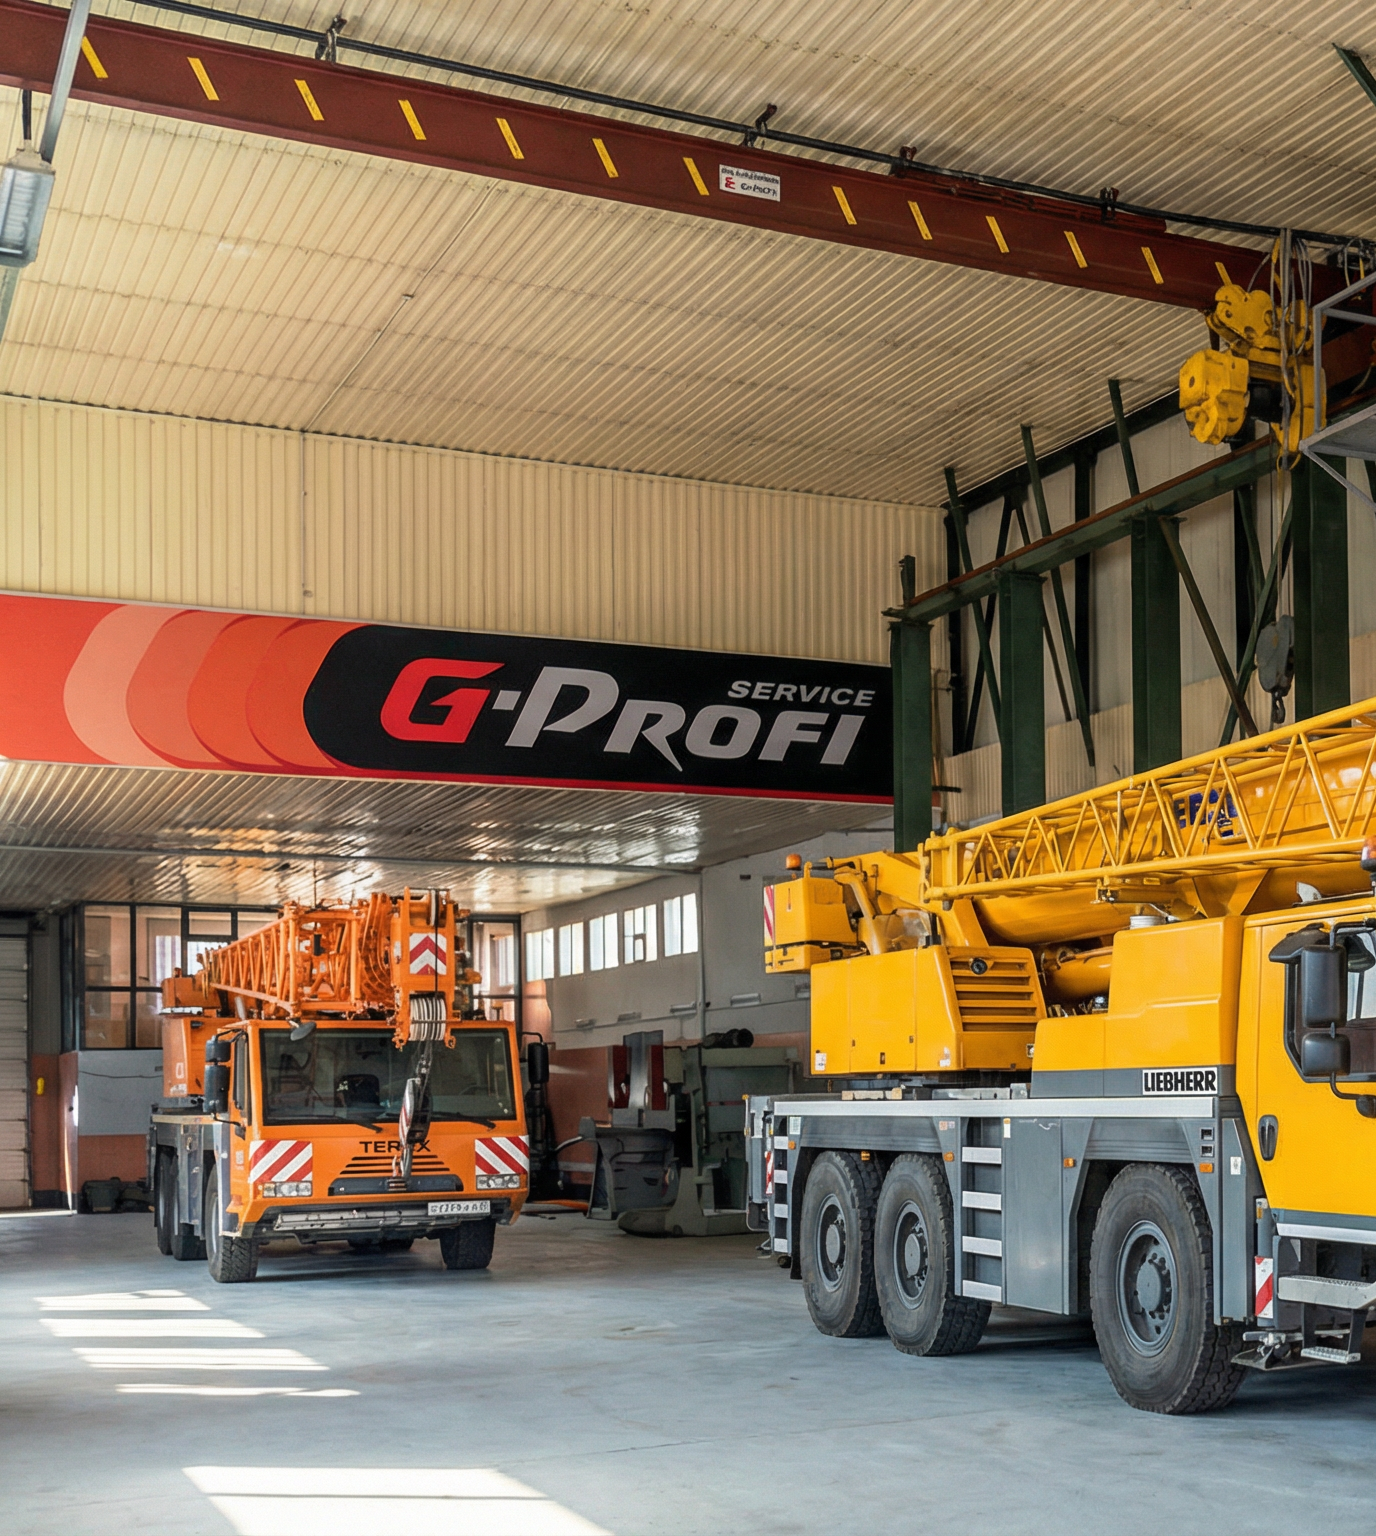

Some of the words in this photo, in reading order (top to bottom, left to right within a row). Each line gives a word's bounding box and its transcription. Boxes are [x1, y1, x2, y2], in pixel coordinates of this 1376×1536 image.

[727, 680, 876, 707] SERVICE
[380, 657, 866, 771] G-PROFI
[1144, 1070, 1217, 1092] LIEBHERR
[359, 1140, 431, 1153] TERX
